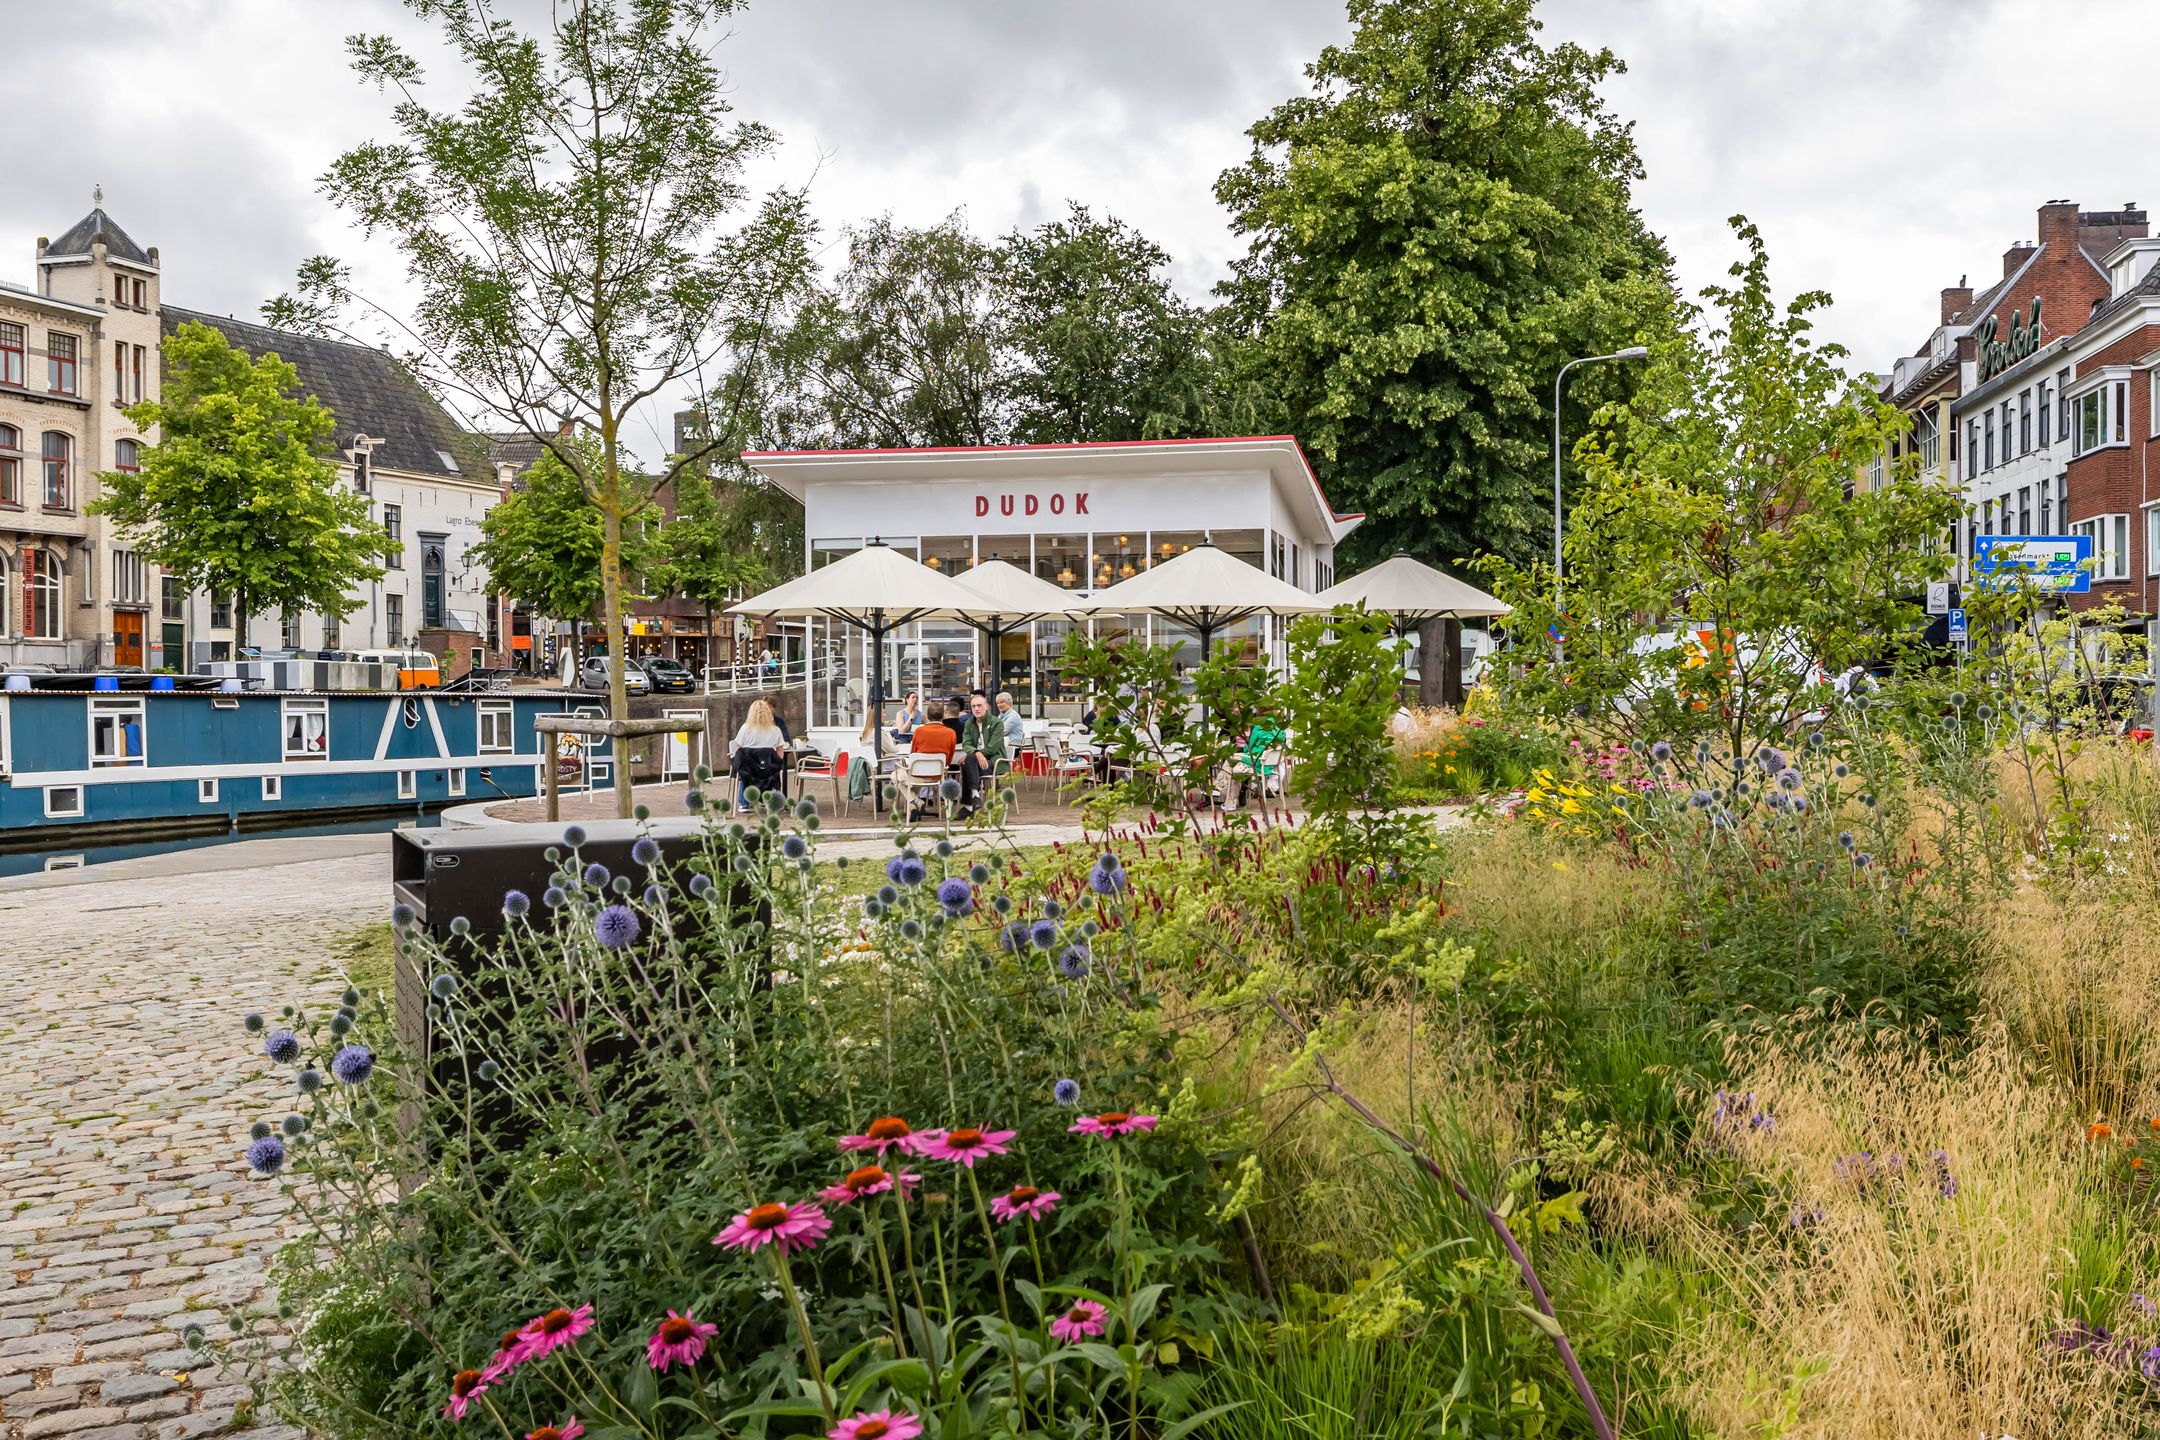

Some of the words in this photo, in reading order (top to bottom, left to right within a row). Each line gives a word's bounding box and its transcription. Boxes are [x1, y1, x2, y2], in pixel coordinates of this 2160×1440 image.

[1978, 295, 2041, 384] Grolsch
[975, 493, 1089, 517] DUDOK
[445, 515, 462, 527] Lagro
[25, 555, 33, 582] ballast
[25, 590, 33, 631] bonekamp
[1952, 611, 1962, 623] P
